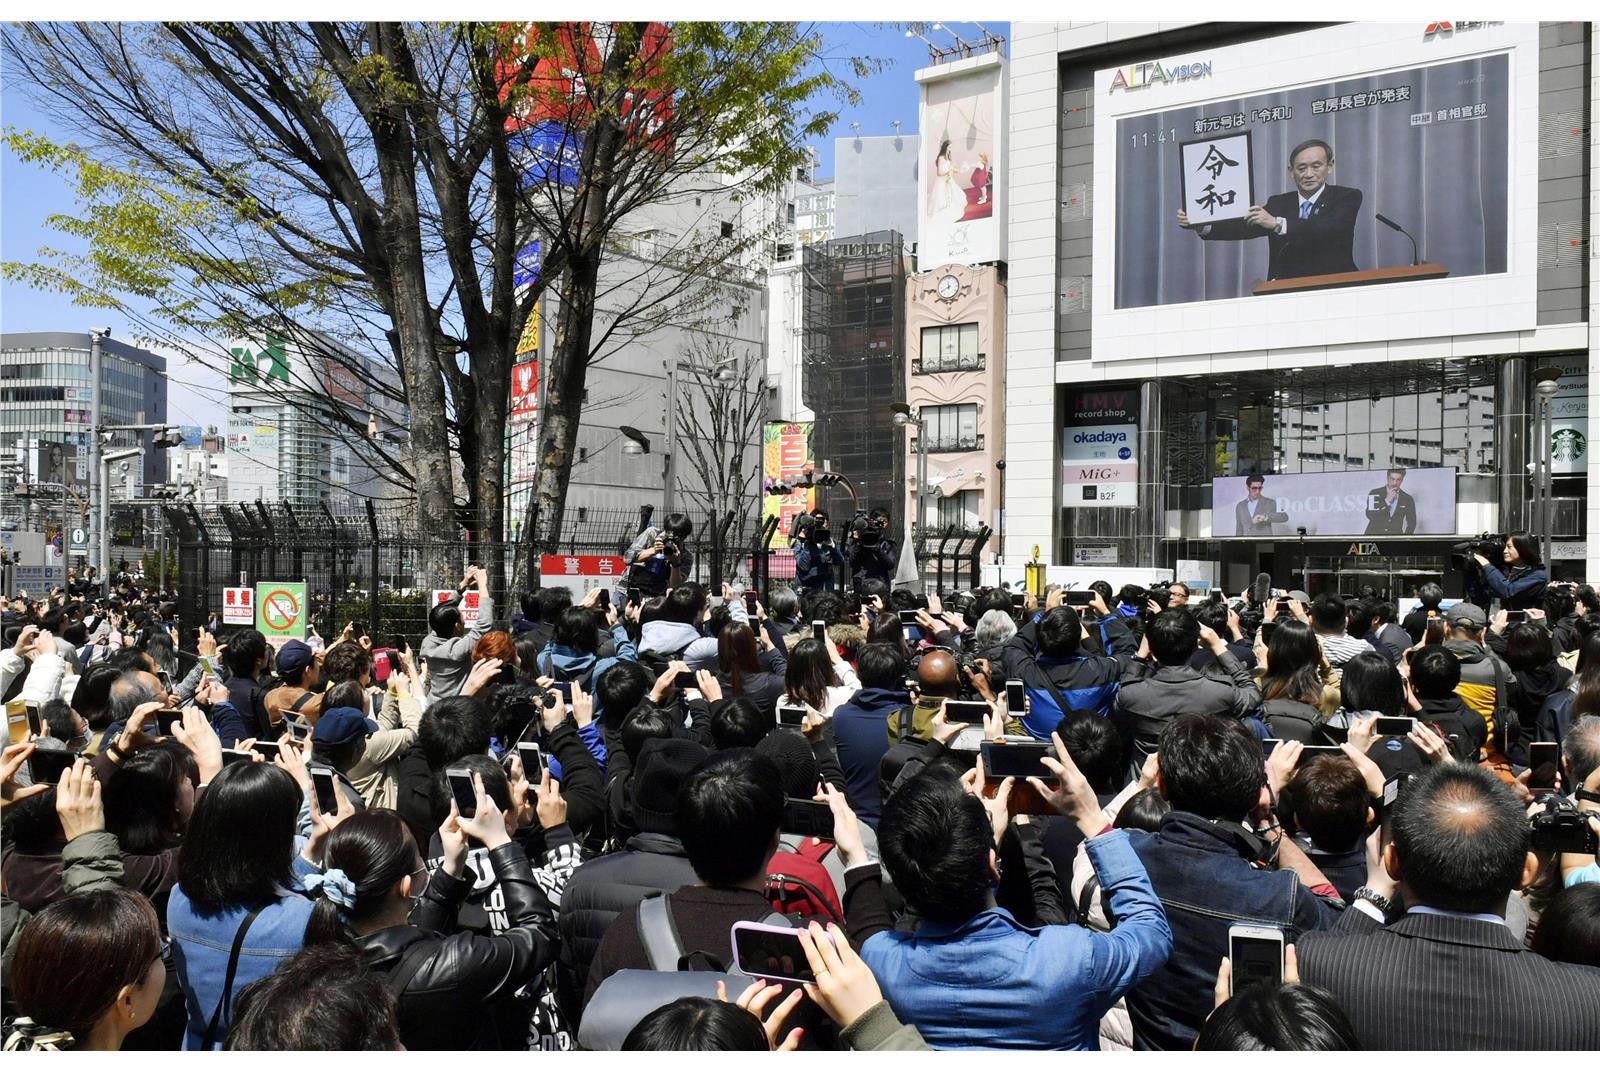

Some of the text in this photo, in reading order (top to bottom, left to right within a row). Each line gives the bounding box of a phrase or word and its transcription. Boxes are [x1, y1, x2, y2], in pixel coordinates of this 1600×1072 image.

[1109, 60, 1212, 93] ALTA VISION
[1194, 86, 1411, 133] 新元号は「令和」 官房長官が発表
[1436, 103, 1487, 121] 首相官邸
[1131, 128, 1176, 149] 11:41
[1194, 144, 1240, 216] 令和
[1074, 408, 1126, 418] record shop
[1073, 431, 1127, 444] okadaya
[1079, 468, 1120, 480] MiG+
[1100, 491, 1116, 501] B2F
[1346, 542, 1380, 556] ALTA
[564, 557, 613, 575] 警告
